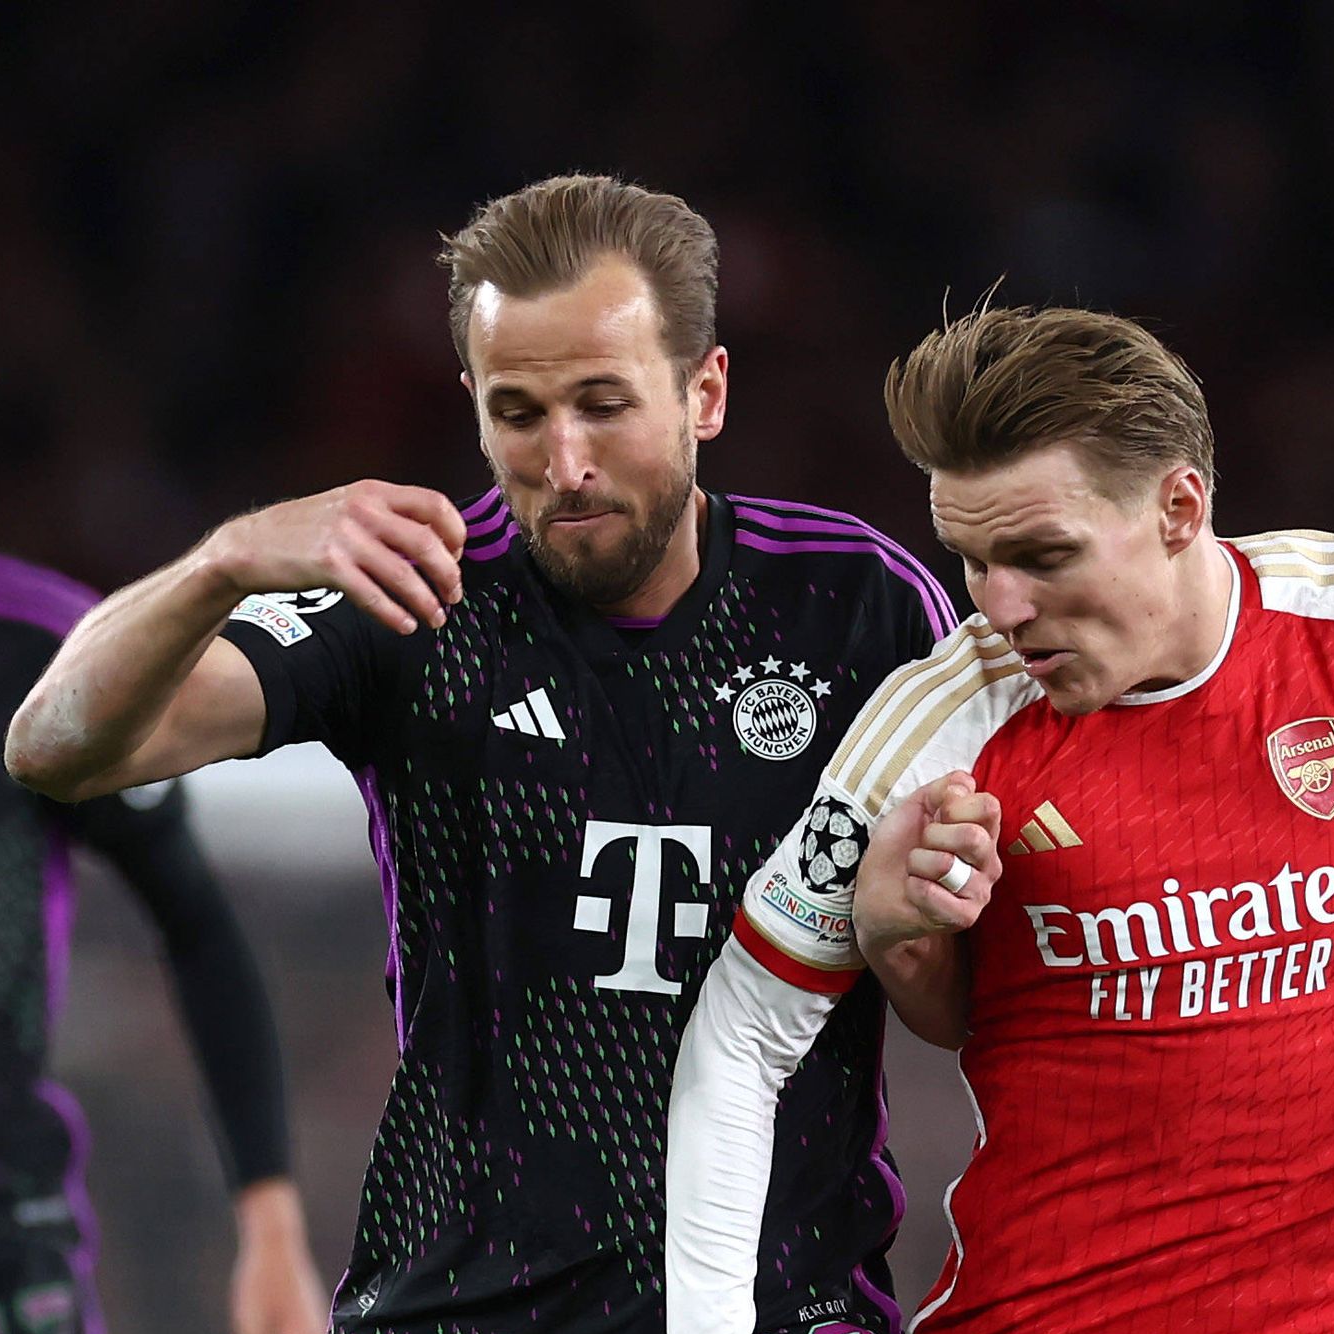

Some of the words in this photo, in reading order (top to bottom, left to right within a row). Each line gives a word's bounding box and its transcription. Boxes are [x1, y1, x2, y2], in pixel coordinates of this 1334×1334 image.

[741, 697, 756, 714] FC
[755, 685, 808, 713] BAYERN
[573, 820, 712, 994] T
[763, 880, 854, 932] FOUNDATIO
[1090, 966, 1162, 1020] FLY
[1180, 938, 1332, 1018] BETTER
